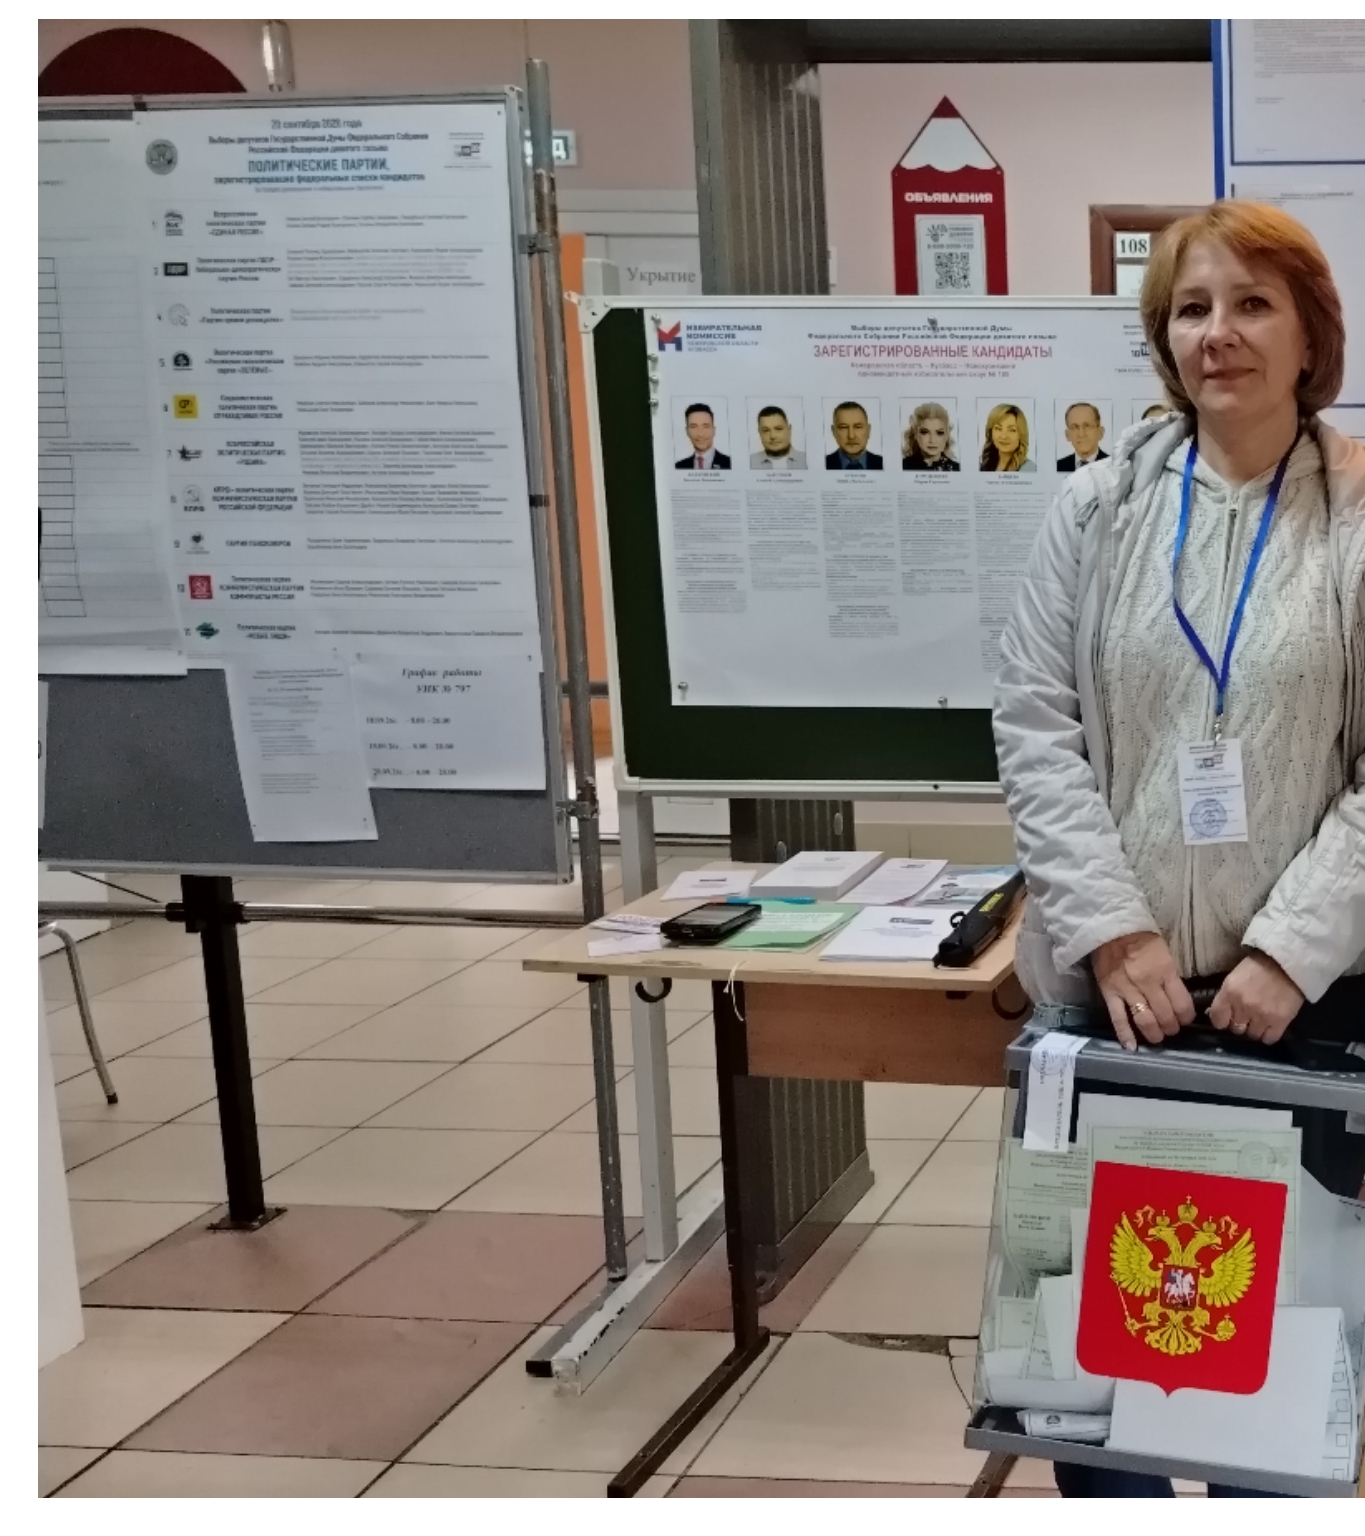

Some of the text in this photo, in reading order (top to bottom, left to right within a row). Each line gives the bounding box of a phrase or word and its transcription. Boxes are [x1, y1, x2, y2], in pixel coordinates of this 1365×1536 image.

[904, 192, 993, 204] ОБЪЯВЛЕНИЯ
[1119, 238, 1148, 254] 108
[626, 267, 696, 285] Укрытие
[813, 345, 1053, 360] ЗАРЕГИСТРИРОВАННЫЕ КАНДИДАТЫ
